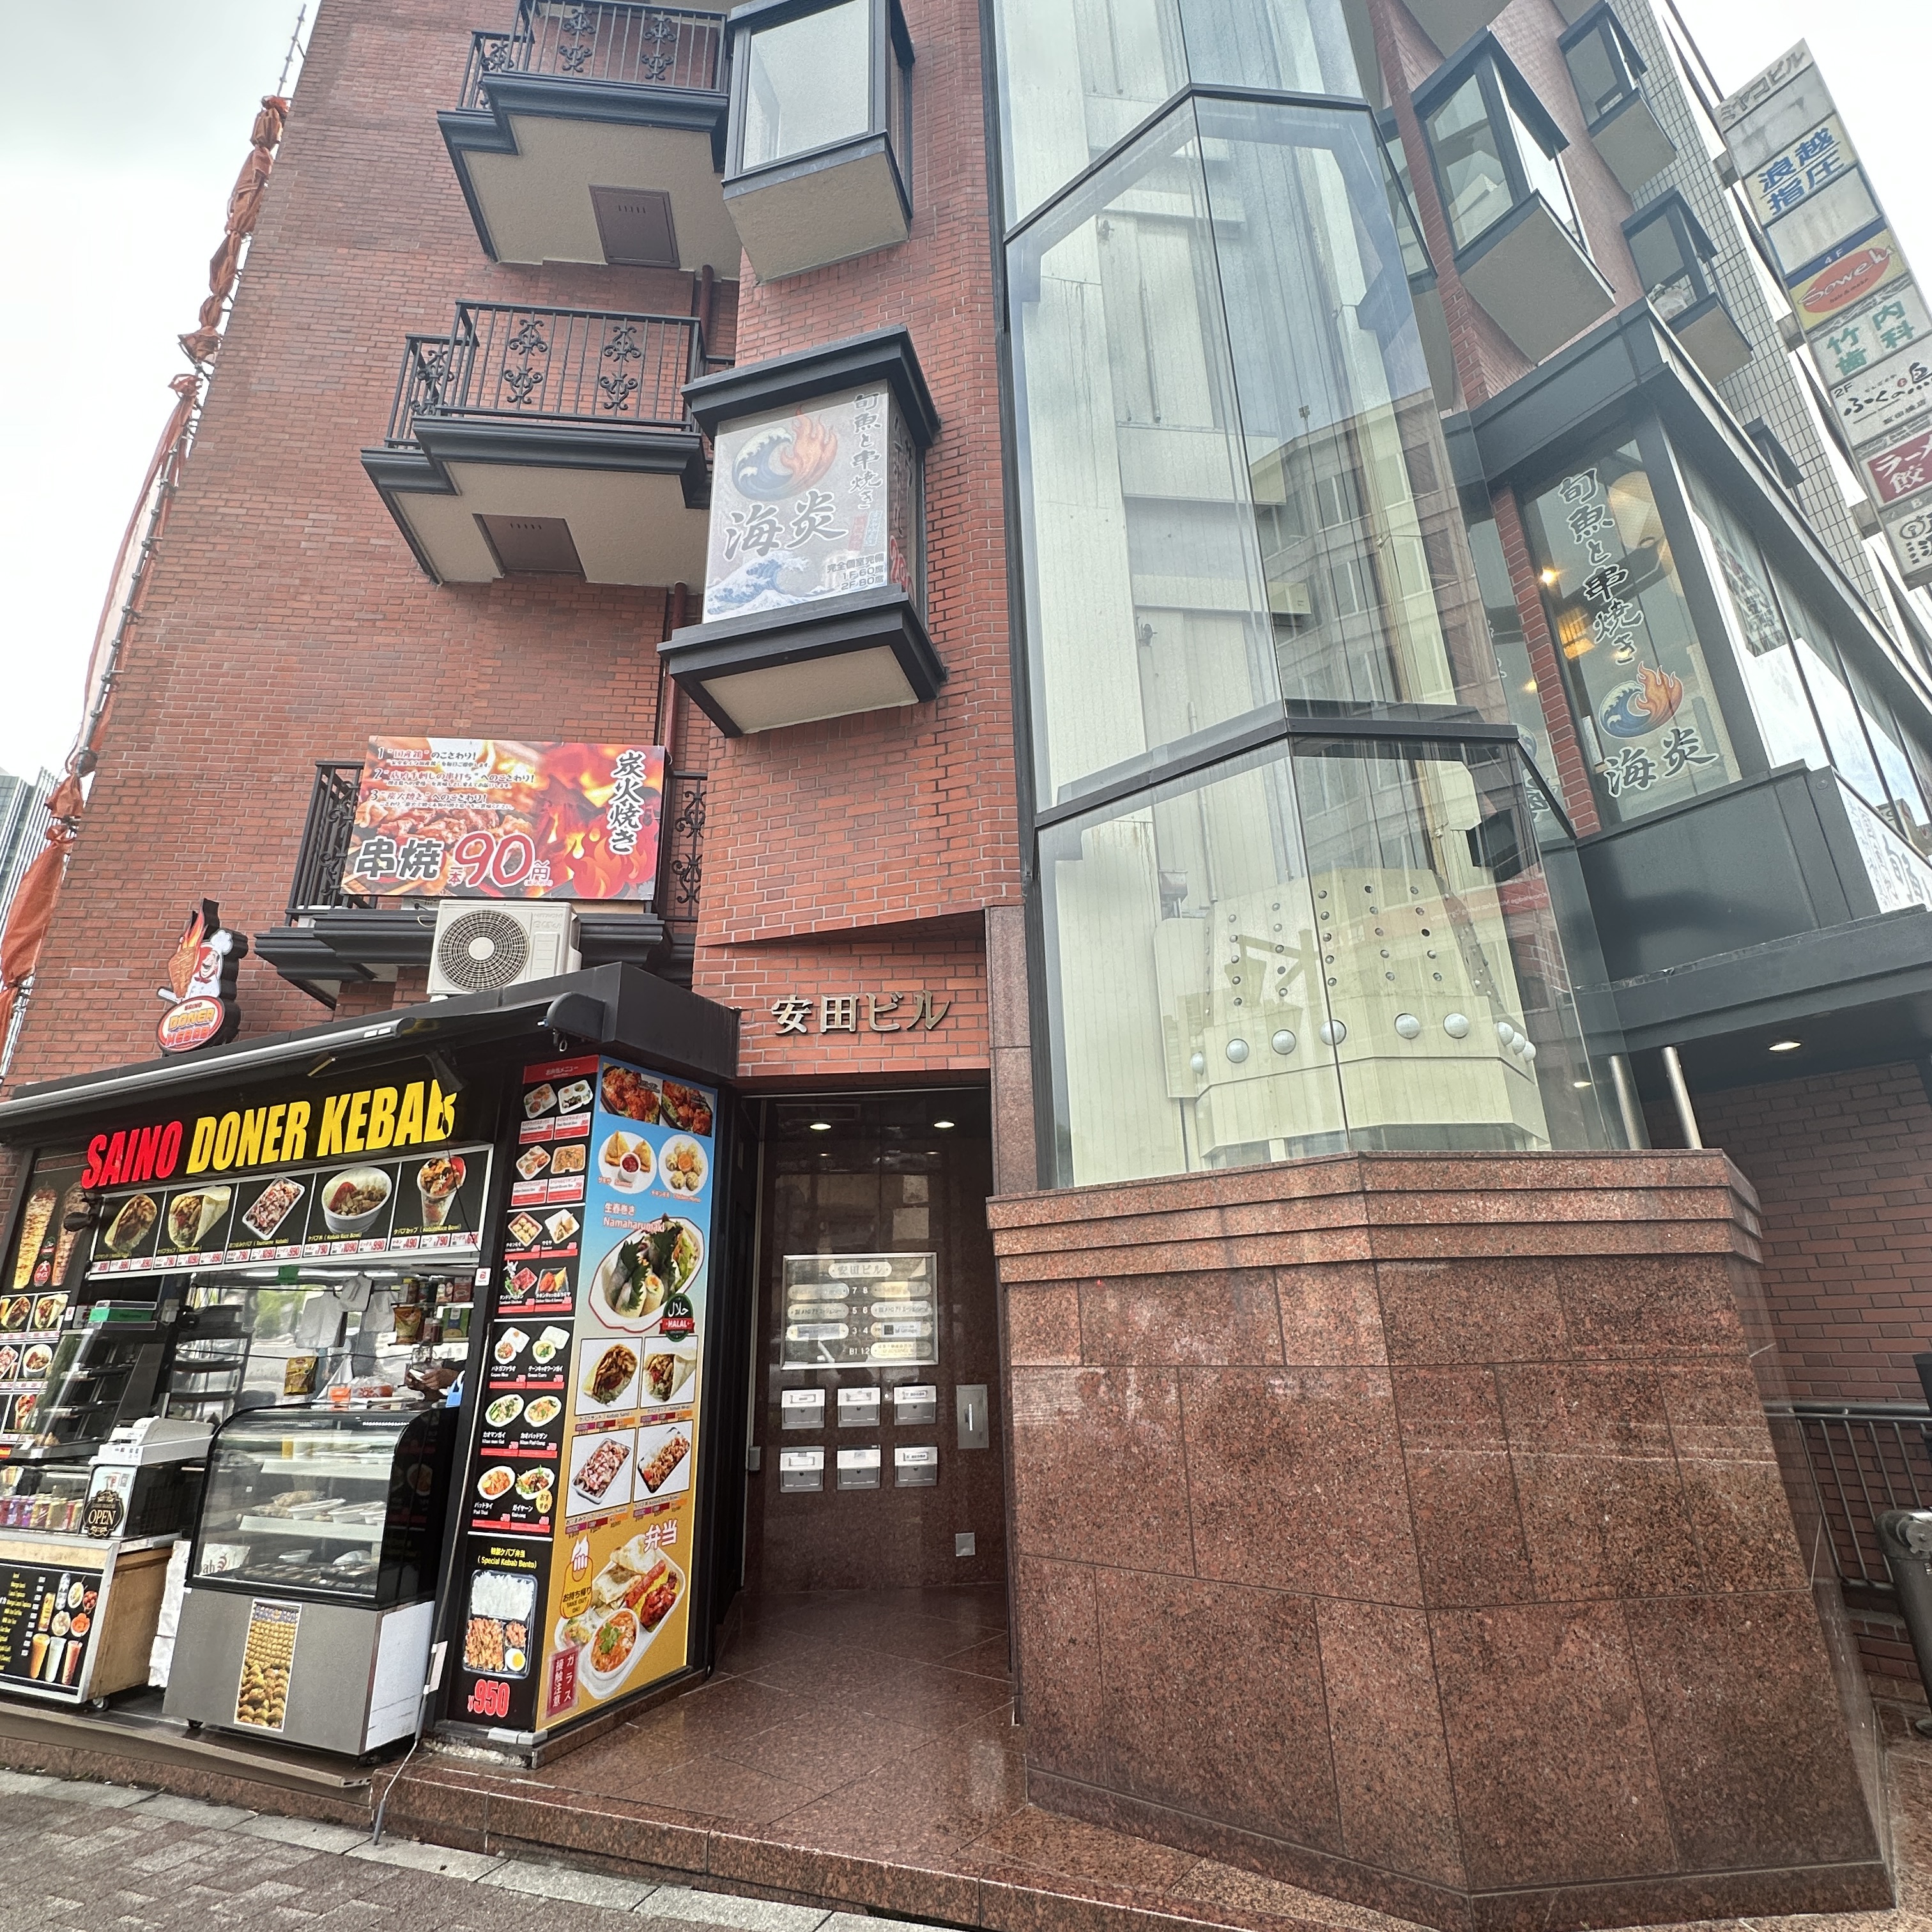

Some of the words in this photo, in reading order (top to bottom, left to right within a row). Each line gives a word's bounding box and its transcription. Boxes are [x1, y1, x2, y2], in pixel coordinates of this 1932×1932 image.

[1721, 51, 1805, 122] ミヤコビル
[1758, 128, 1834, 192] 浪越
[1767, 149, 1844, 216] 指圧
[1826, 300, 1905, 353] 竹内
[1835, 324, 1915, 376] 歯科
[1834, 382, 1852, 398] 2F
[849, 392, 882, 509] 旬魚と串焼き
[723, 489, 848, 561] 海炎
[827, 553, 884, 573] 完全個室完備
[1557, 468, 1645, 666] 旬魚と串焼き
[1604, 728, 1718, 797] 海炎
[606, 749, 647, 855] 炭火焼き
[355, 836, 444, 881] 串焼
[454, 831, 535, 887] 90
[169, 1008, 215, 1031] DONER
[771, 990, 950, 1034] 安田ビル
[165, 1025, 211, 1047] KEBAB
[80, 1121, 183, 1189] SAINO
[185, 1100, 311, 1174] DONER
[316, 1078, 457, 1157] KEBAB
[603, 1216, 665, 1232] Namaharumaki
[604, 1202, 635, 1215] 生春巻き
[838, 1265, 882, 1275] 安田ビル
[668, 1302, 689, 1317] حلال
[89, 1509, 116, 1525] OPEN
[643, 1518, 678, 1552] 弁当
[500, 1558, 518, 1567] Kebab
[563, 1586, 592, 1602] お持ち帰り
[468, 1678, 510, 1717] ¥950
[553, 1659, 564, 1707] 接触注意
[564, 1655, 575, 1702] ガラス
